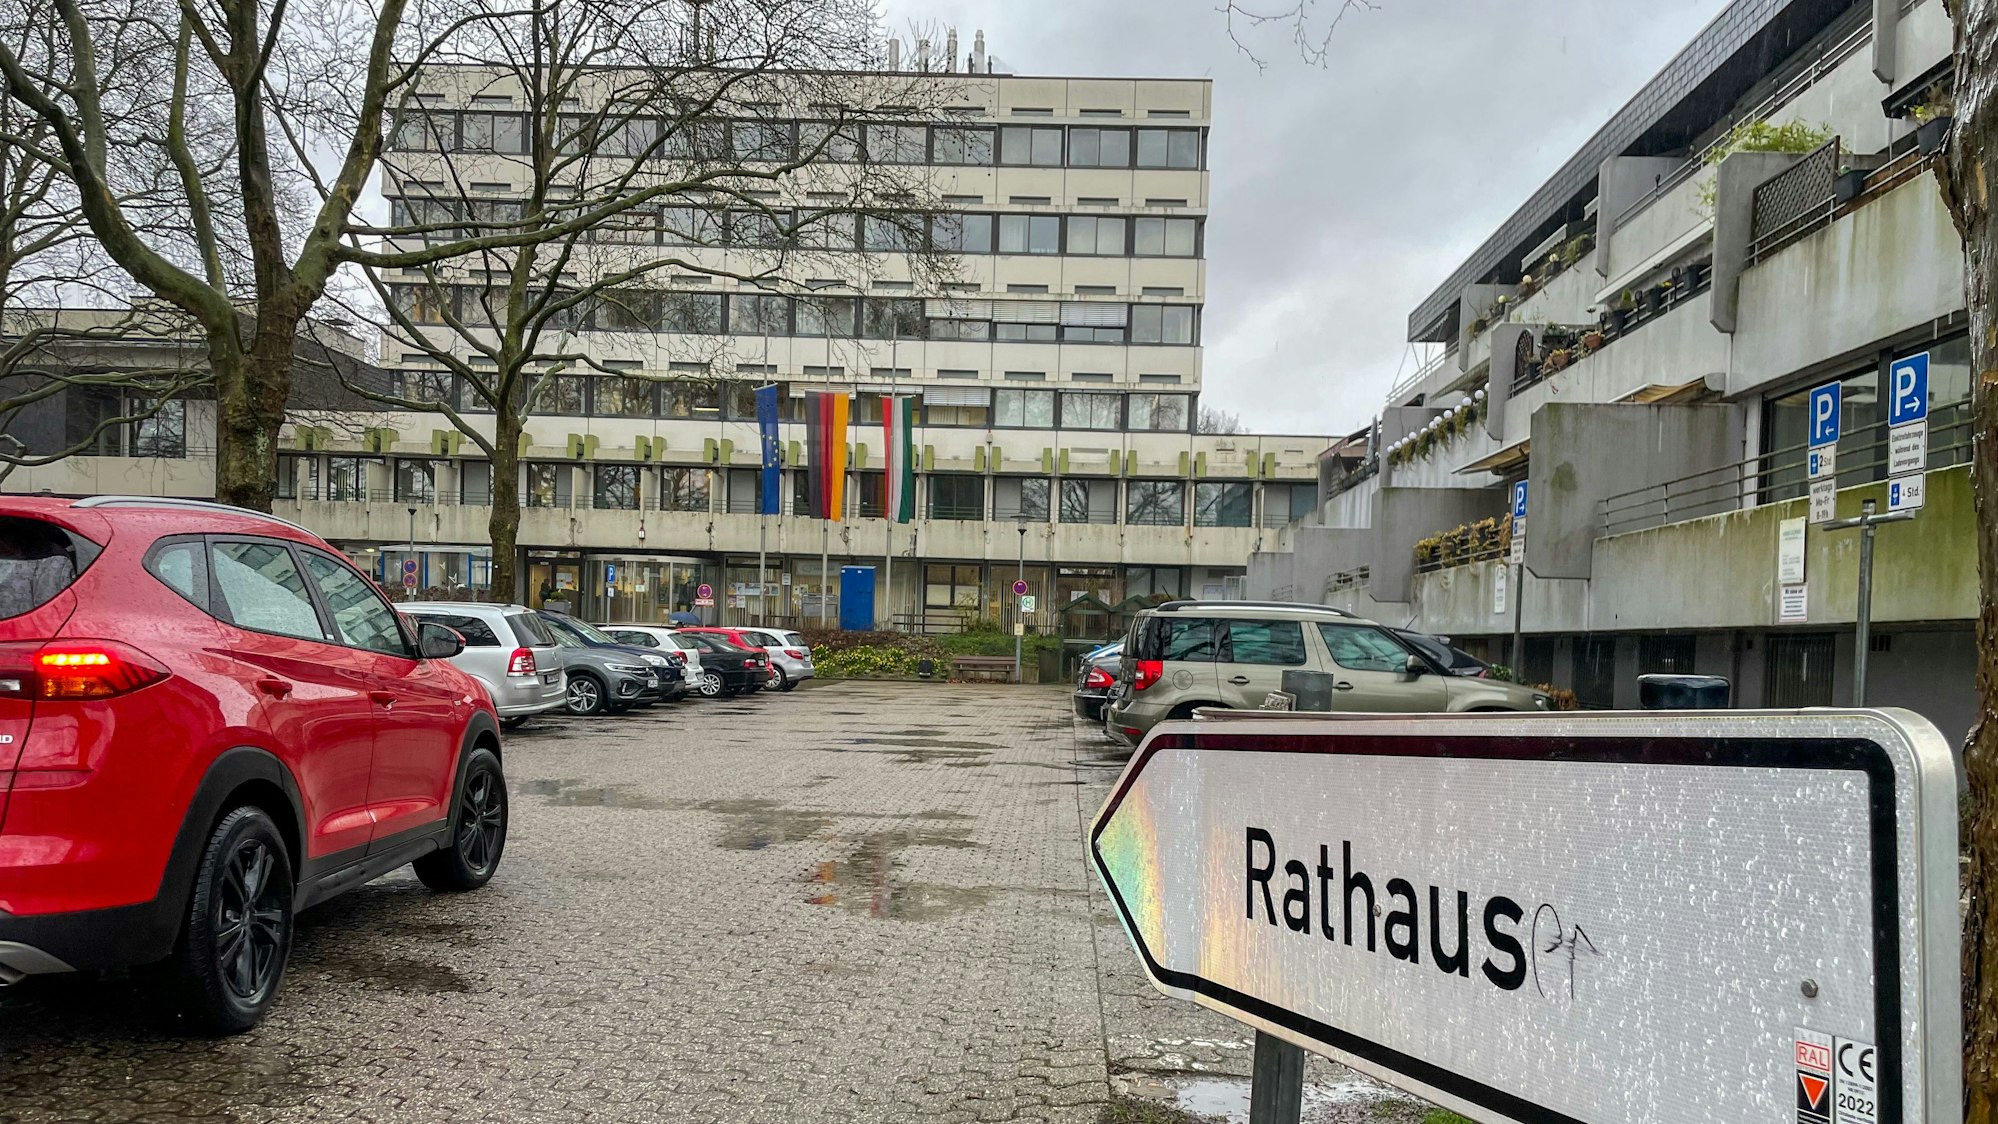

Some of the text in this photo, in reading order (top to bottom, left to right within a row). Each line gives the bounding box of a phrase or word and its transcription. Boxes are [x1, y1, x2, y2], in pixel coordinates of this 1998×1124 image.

[1895, 366, 1917, 417] P
[1816, 393, 1834, 439] P
[1819, 455, 1824, 467] 2
[1515, 486, 1525, 514] P
[1246, 826, 1527, 991] Rathaus
[1798, 1045, 1827, 1067] RAL
[1838, 1043, 1874, 1083] CE
[1838, 1092, 1874, 1117] 2022
